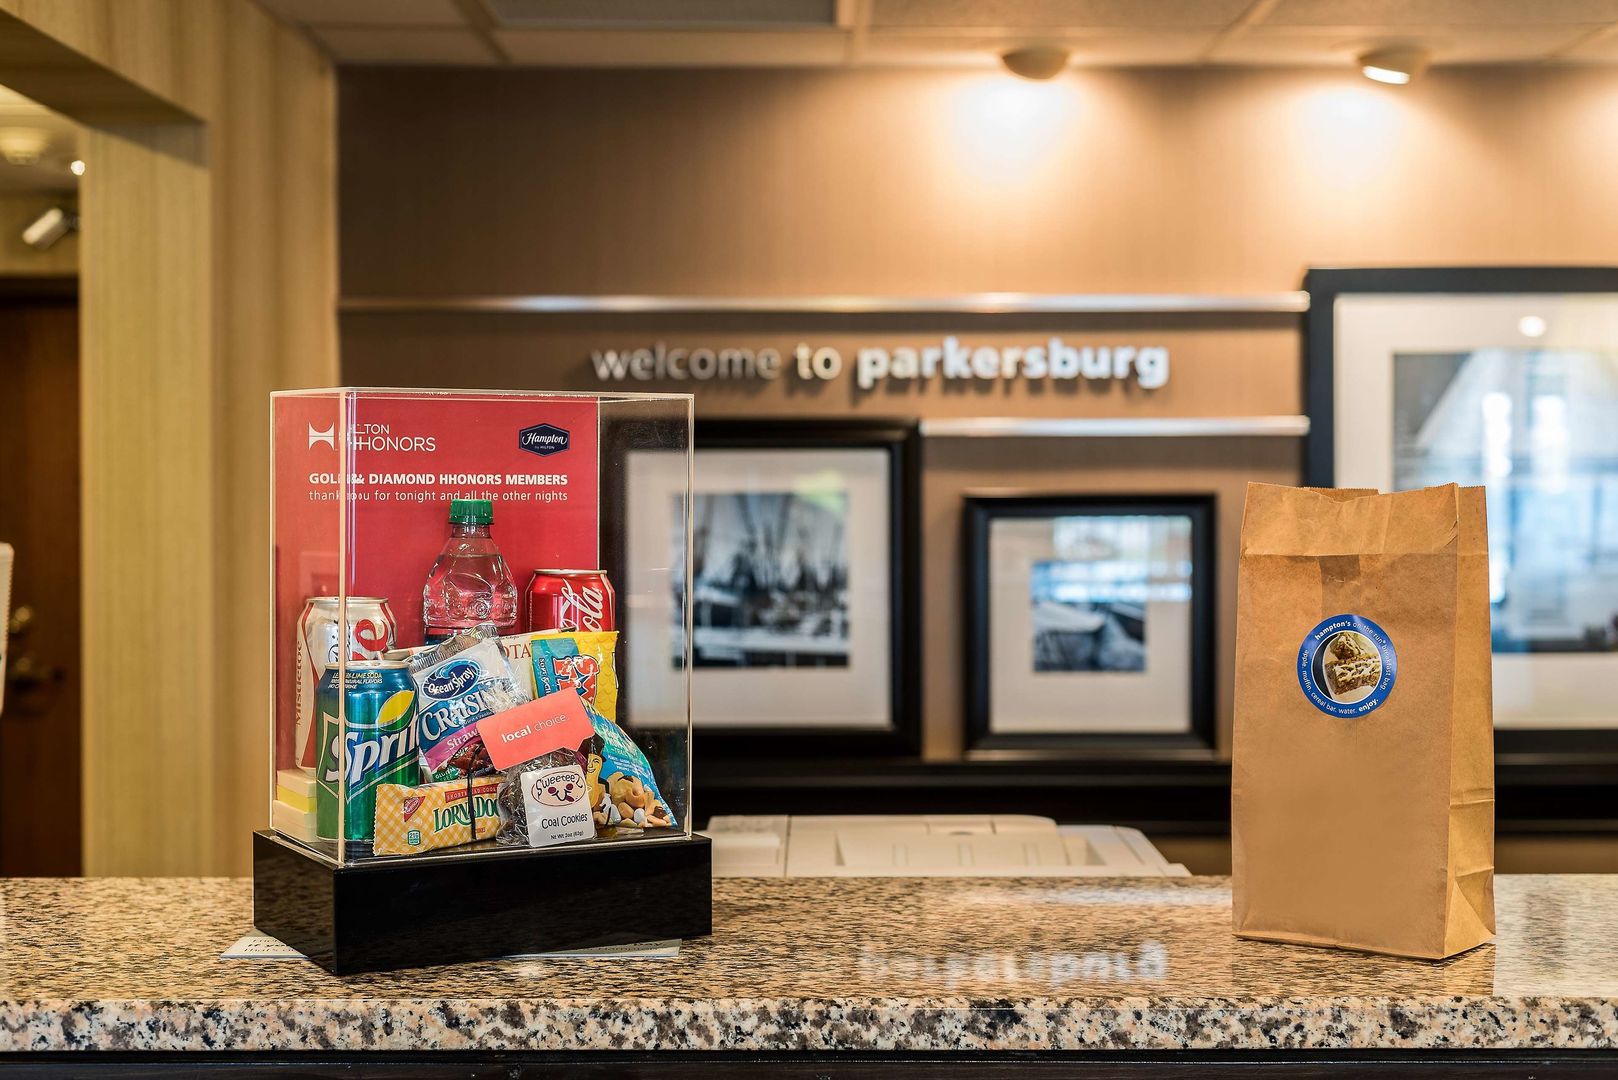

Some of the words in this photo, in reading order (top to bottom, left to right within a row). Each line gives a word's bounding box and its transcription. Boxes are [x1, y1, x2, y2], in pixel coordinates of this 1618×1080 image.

[590, 341, 782, 381] welcome
[793, 342, 842, 380] to
[856, 335, 1170, 389] parkersburg
[522, 432, 568, 446] Hampton
[309, 473, 343, 485] GOL
[369, 474, 435, 485] DIAMOND
[440, 474, 502, 485] HHONORS
[506, 475, 568, 485] MEMBERS
[375, 490, 390, 501] for
[396, 490, 436, 502] tonight
[440, 490, 460, 501] and
[465, 490, 477, 500] all
[482, 490, 498, 501] the
[503, 491, 531, 501] other
[536, 491, 568, 502] nights
[1315, 621, 1351, 640] hampton's
[428, 680, 454, 695] Ocean
[451, 667, 475, 688] Spray
[1311, 692, 1325, 707] cereal
[1358, 698, 1379, 712] enjoy.
[501, 725, 532, 743] local
[534, 713, 567, 731] choice
[446, 728, 478, 750] Straw
[433, 801, 472, 833] LORN
[541, 817, 560, 829] Coal
[560, 812, 588, 827] Cookies
